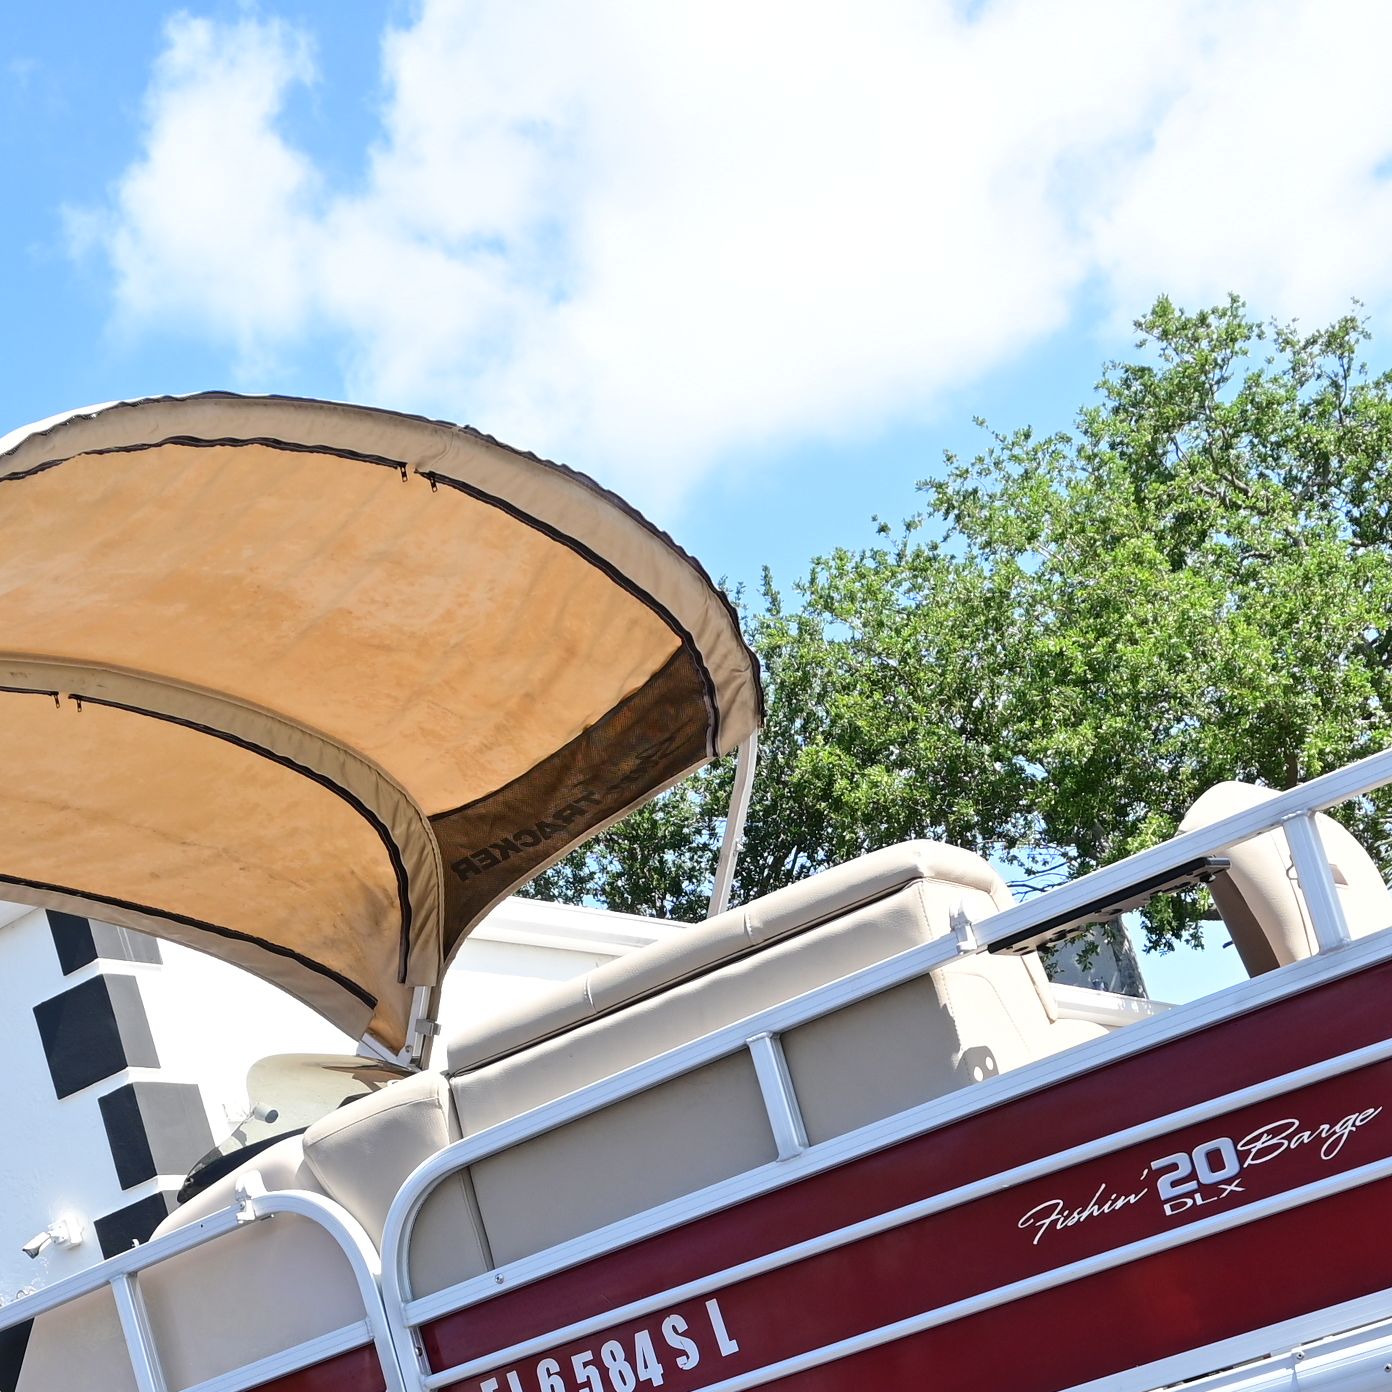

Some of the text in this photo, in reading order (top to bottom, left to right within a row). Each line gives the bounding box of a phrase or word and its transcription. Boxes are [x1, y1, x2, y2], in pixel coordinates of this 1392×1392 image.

[1017, 1105, 1383, 1245] Fishin' 20 Barge
[1164, 1179, 1246, 1216] DLX
